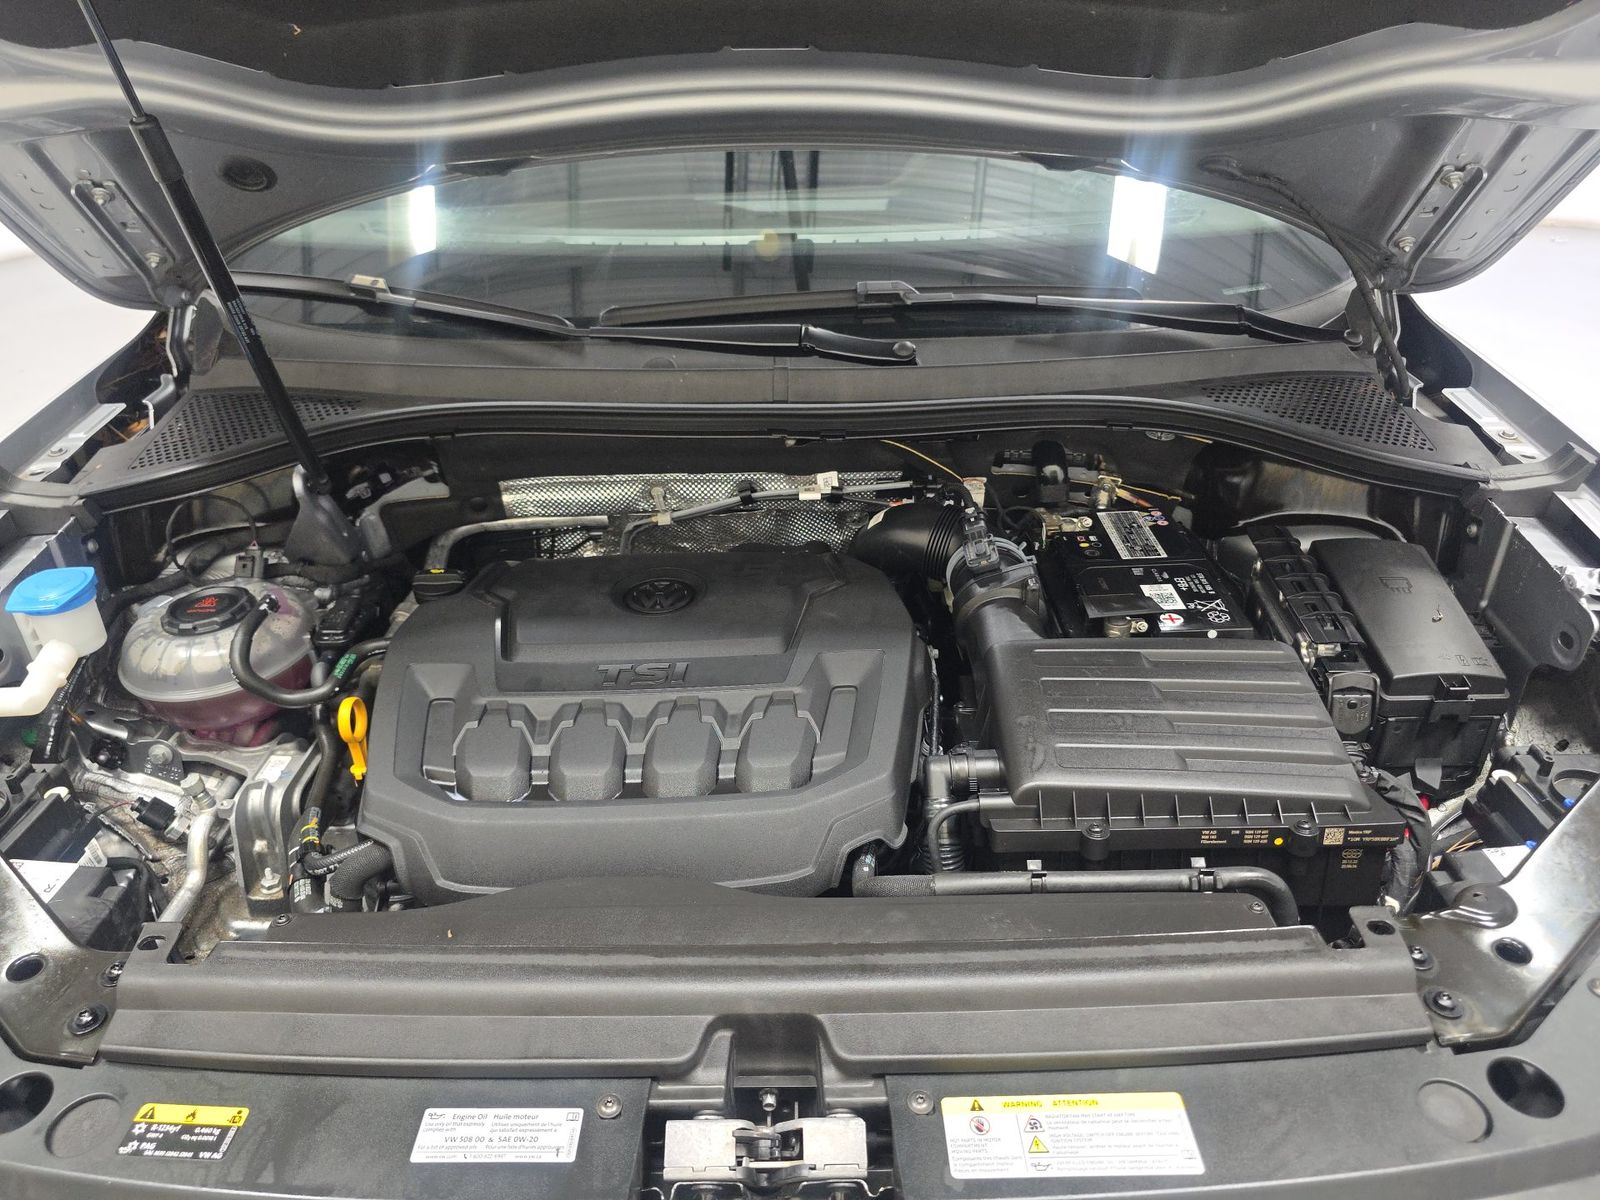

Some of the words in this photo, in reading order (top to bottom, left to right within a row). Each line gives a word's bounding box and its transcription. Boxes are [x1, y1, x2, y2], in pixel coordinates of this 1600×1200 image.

[598, 662, 689, 687] TSI
[452, 1113, 476, 1121] Engine
[150, 1124, 182, 1134] R-1234yf
[213, 1127, 222, 1135] kg
[513, 1135, 539, 1143] 0W-20
[139, 1141, 157, 1150] PAG
[198, 1151, 212, 1159] VW
[211, 1152, 223, 1160] AG
